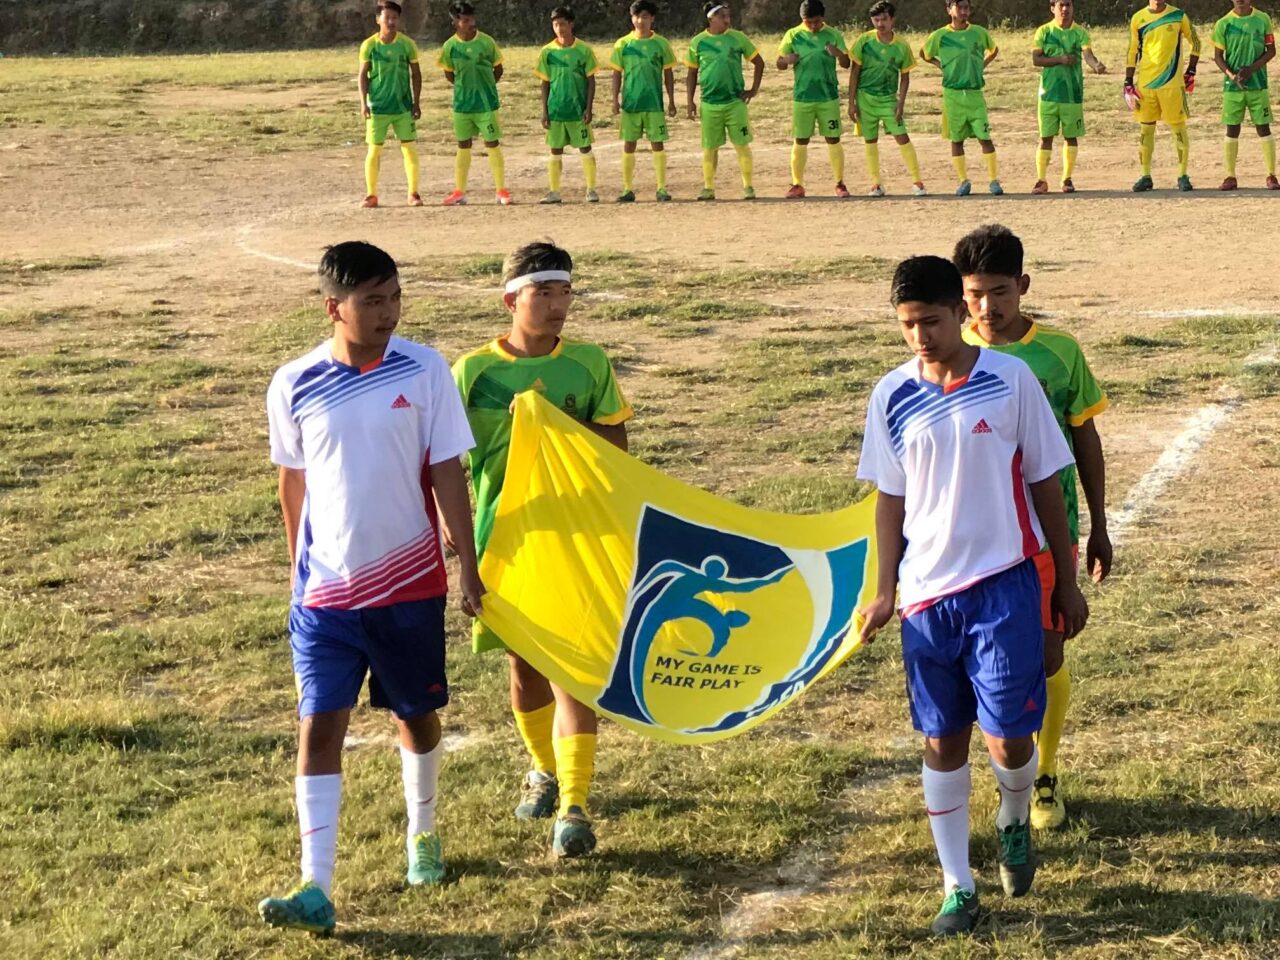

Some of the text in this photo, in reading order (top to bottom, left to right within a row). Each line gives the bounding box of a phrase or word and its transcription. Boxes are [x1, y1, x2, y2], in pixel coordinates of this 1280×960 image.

[655, 656, 763, 675] MY GAME IS
[651, 672, 744, 690] FAIR PLAY
